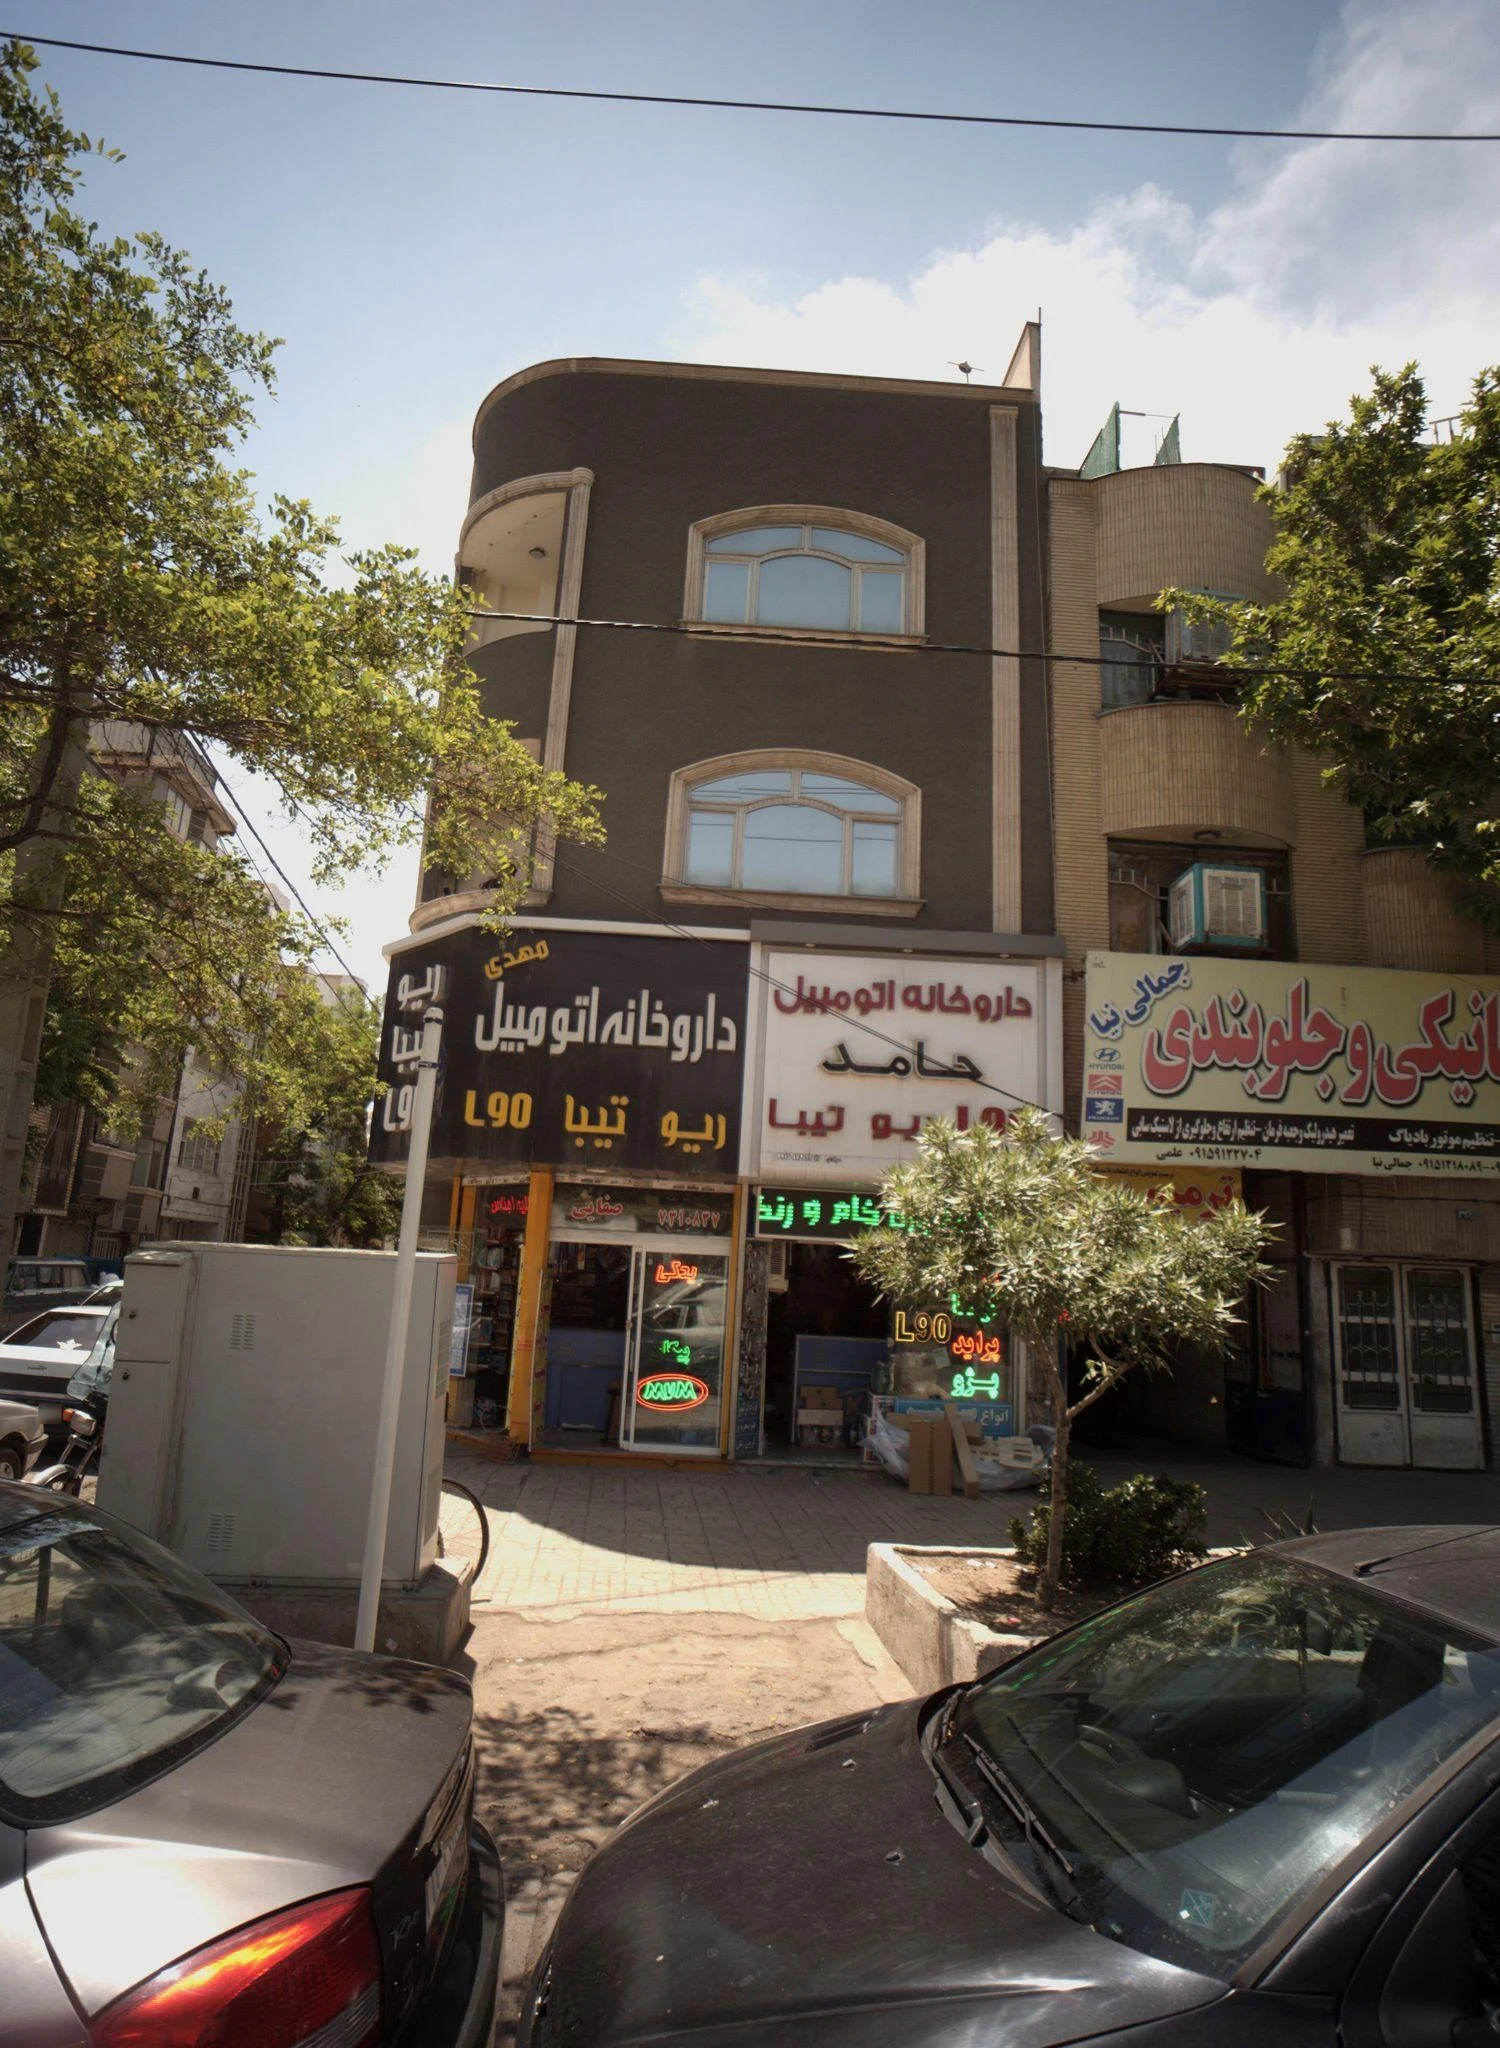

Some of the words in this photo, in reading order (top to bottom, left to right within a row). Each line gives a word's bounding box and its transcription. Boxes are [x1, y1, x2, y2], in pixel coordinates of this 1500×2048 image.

[483, 939, 550, 981] مهدی
[397, 963, 446, 1011] ریو
[774, 975, 895, 1015] اتومبیل
[901, 982, 1033, 1023] داروخانه
[1126, 961, 1186, 1022] جمالی
[475, 980, 600, 1055] اتومبیل
[600, 988, 738, 1063] داروخانه
[1090, 1003, 1121, 1036] نیا
[819, 1039, 984, 1080] حامد
[1374, 988, 1500, 1105] انیکی
[383, 1085, 418, 1132] L9
[464, 1089, 533, 1130] L90
[564, 1093, 630, 1149] تیبا
[768, 1098, 845, 1137] تیبا
[660, 1109, 727, 1154] ریو
[1156, 1147, 1183, 1161] علمی
[1372, 1156, 1383, 1168] نیا
[1384, 1157, 1413, 1170] جمالی
[894, 1310, 952, 1344] L90
[952, 1330, 1000, 1363] پراید
[951, 1366, 1000, 1399] پژو
